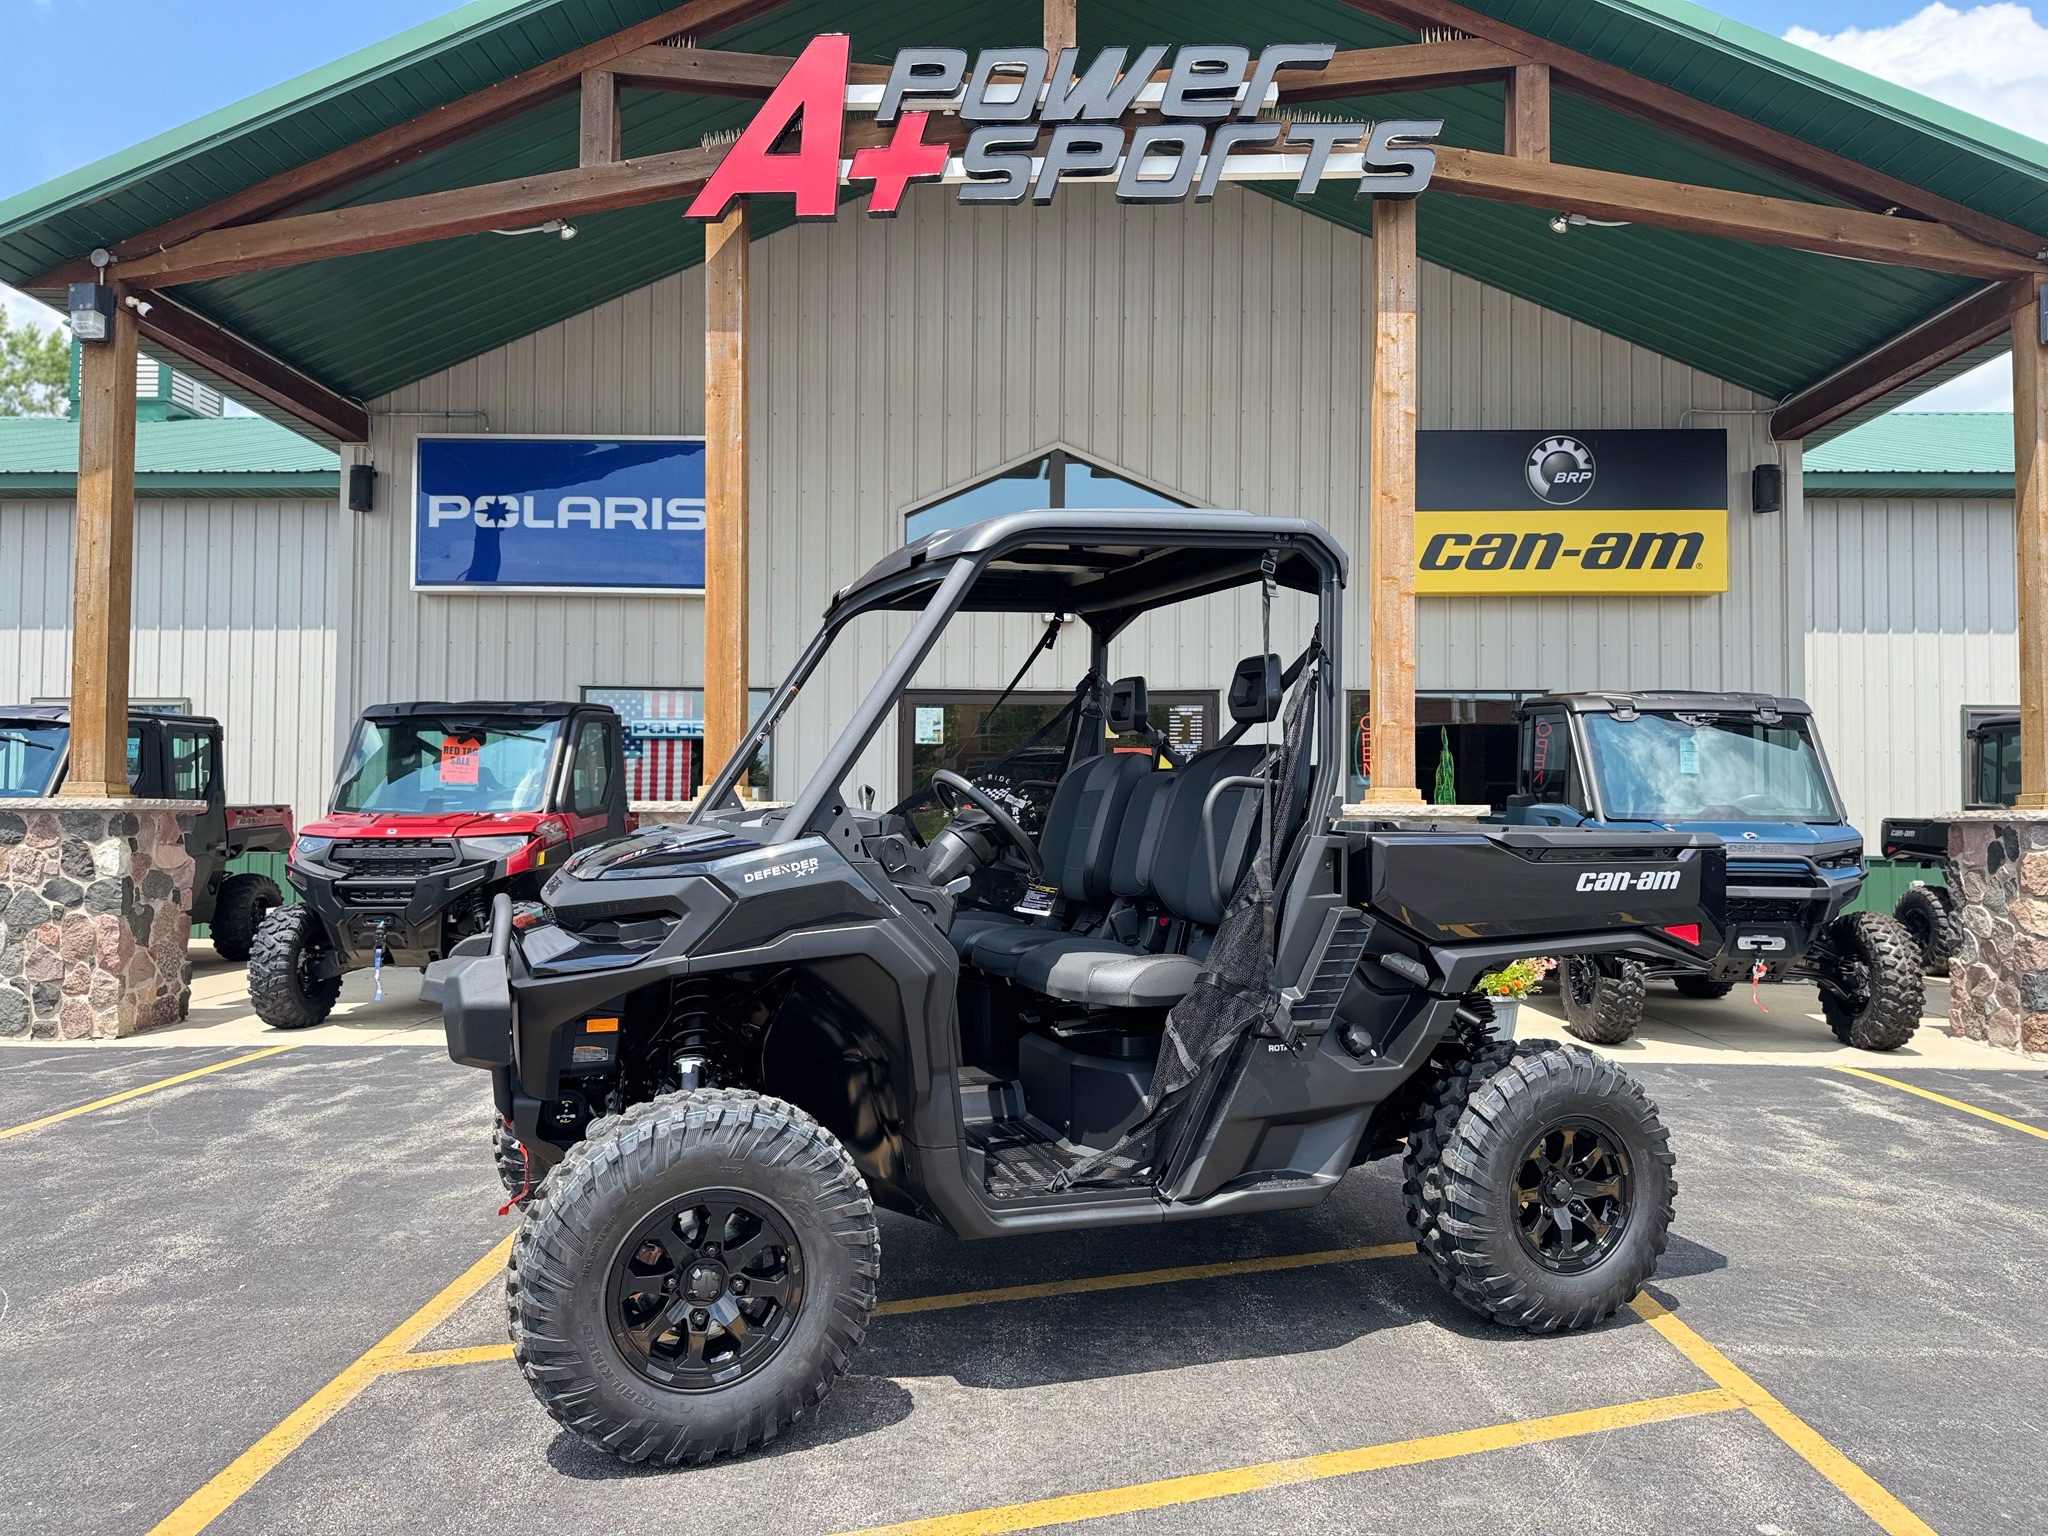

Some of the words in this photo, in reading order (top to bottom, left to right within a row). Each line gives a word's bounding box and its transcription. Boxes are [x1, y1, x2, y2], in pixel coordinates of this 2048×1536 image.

[1553, 471, 1592, 484] BRP
[428, 495, 706, 531] POLARIS
[633, 722, 704, 734] POLAR
[443, 745, 460, 756] RED
[462, 747, 479, 757] TAG
[450, 756, 471, 766] SALE
[988, 773, 1011, 785] RIDE
[1019, 788, 1037, 818] TARTS
[743, 857, 819, 884] DEFENDER
[794, 866, 819, 879] XT
